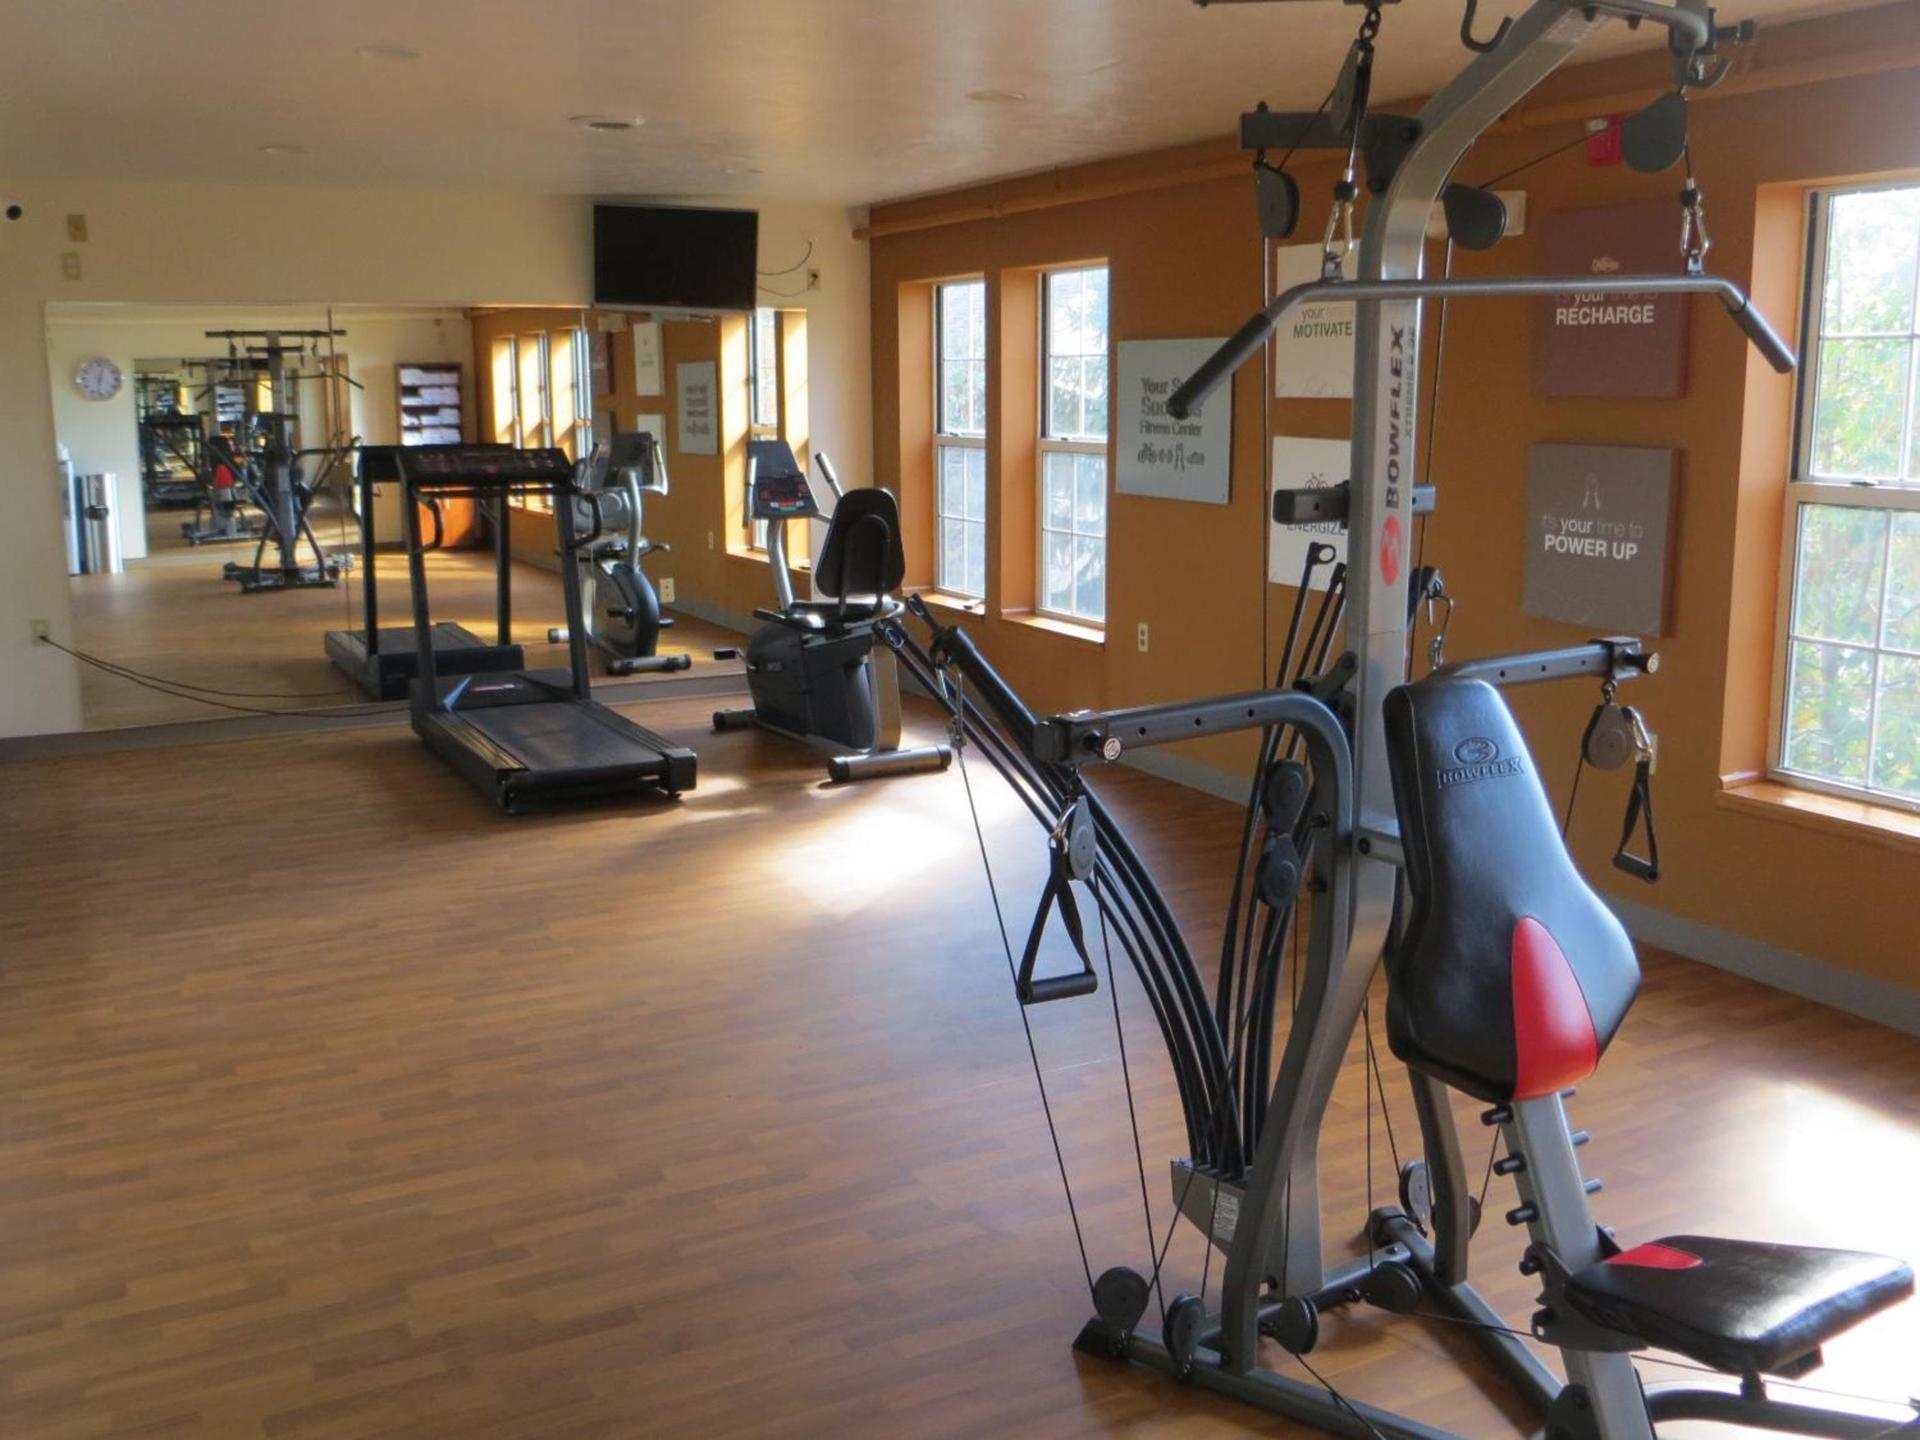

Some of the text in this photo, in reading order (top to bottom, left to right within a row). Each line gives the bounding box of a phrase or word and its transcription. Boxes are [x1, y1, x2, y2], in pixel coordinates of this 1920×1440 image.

[1556, 305, 1655, 325] RECHARGE
[1293, 321, 1353, 338] MOTIVATE
[1141, 377, 1168, 394] Your
[1385, 324, 1404, 509] BOWFLEX
[1140, 420, 1203, 436] Fitness Center
[1560, 517, 1593, 535] your
[1544, 534, 1638, 560] POWER UP
